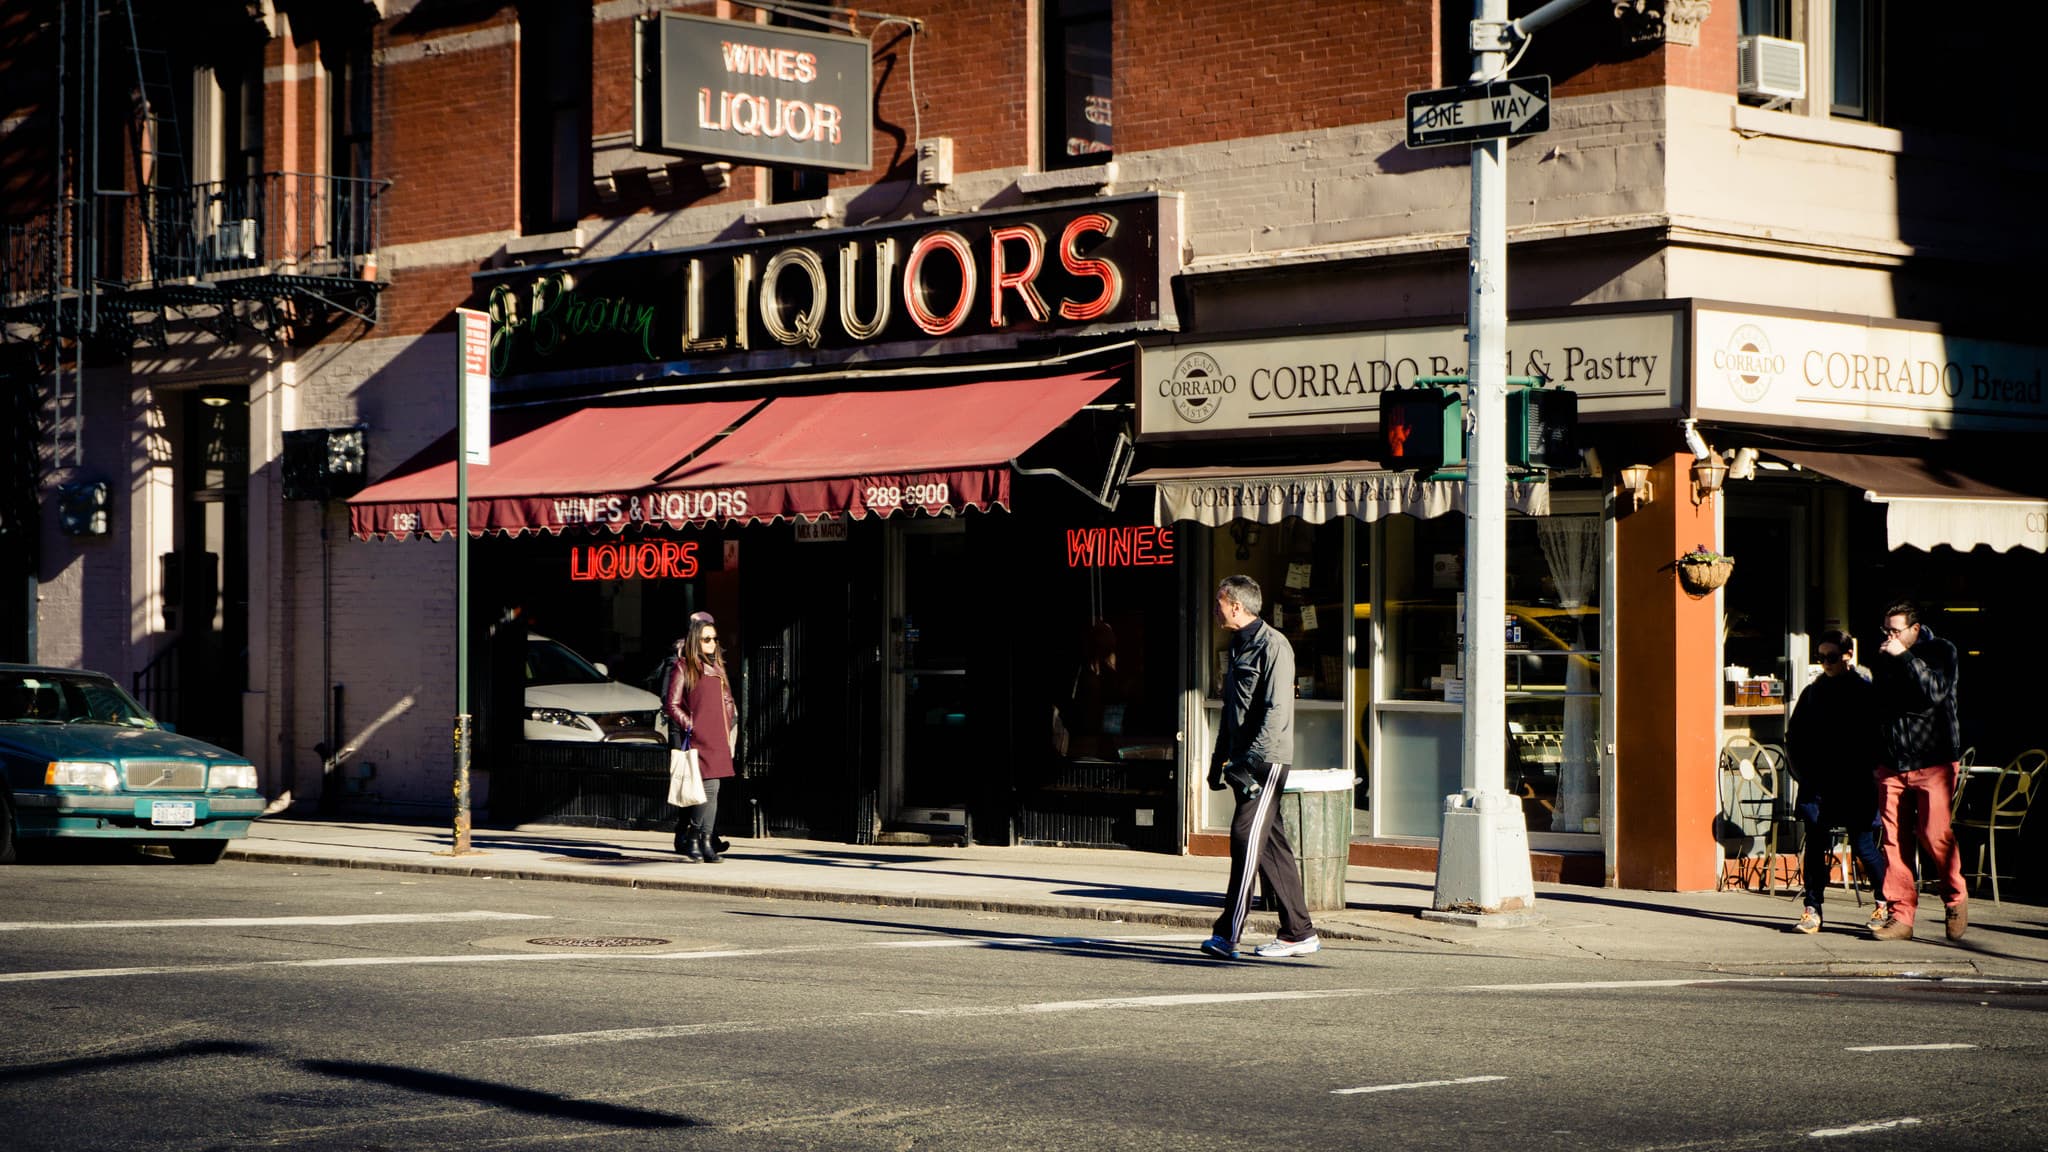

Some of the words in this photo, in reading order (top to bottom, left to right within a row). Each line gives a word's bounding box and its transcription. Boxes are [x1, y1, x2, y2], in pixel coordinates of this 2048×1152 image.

[721, 41, 817, 83] WINES
[698, 87, 842, 145] LIQUOR
[1426, 105, 1464, 129] ONE
[1491, 95, 1531, 120] WAY
[683, 212, 1123, 352] LIQUORS
[1180, 357, 1214, 375] BREAD
[1251, 357, 1419, 401] CORRADO
[1526, 348, 1555, 383] &
[1563, 346, 1658, 387] Pastry
[1803, 350, 1964, 398] CORRADO
[1970, 364, 2042, 404] Bread
[1179, 401, 1214, 418] PASTRY
[553, 497, 622, 524] WINES
[629, 496, 643, 521] &
[649, 490, 747, 520] LIQUORS
[866, 482, 949, 507] 289-6900
[1191, 483, 1285, 507] CORRADO
[392, 511, 421, 531] 1361
[821, 522, 846, 537] MATCH
[571, 541, 699, 581] LIQUORS
[1066, 526, 1174, 567] WINES
